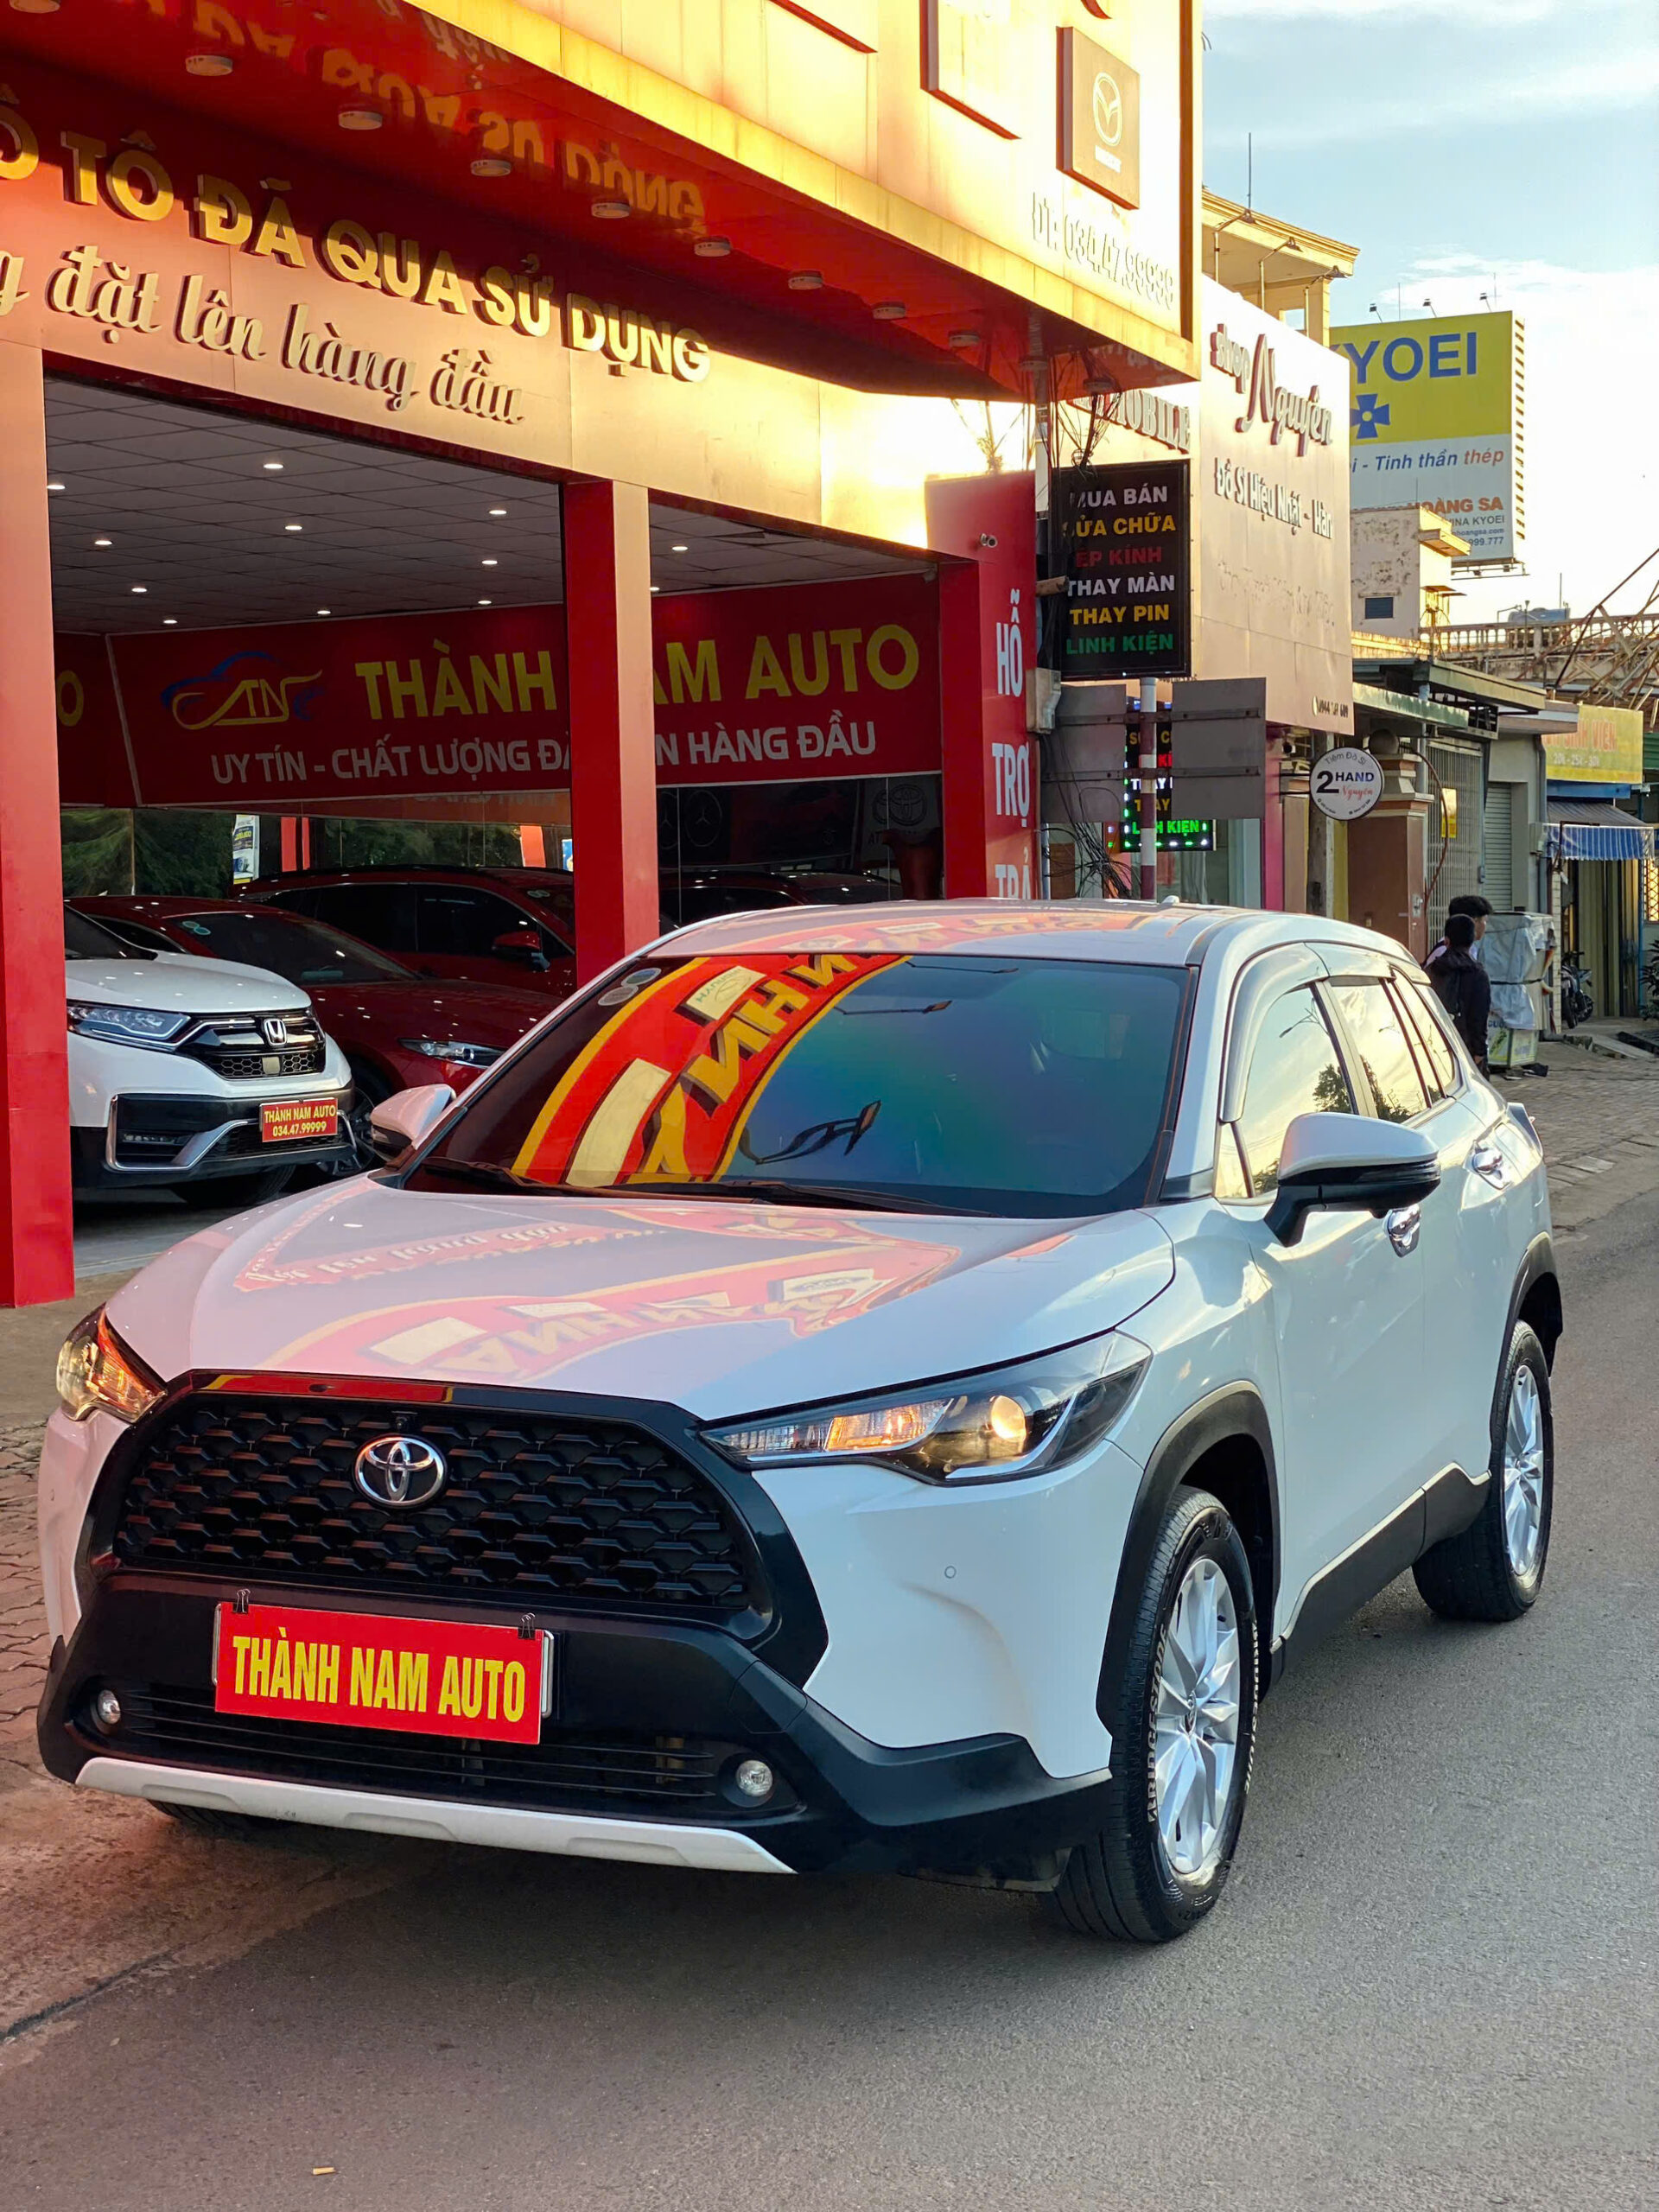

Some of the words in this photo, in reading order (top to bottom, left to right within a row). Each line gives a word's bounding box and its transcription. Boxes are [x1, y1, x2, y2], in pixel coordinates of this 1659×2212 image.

[60, 130, 175, 222] TÔ
[189, 173, 307, 269] ĐÃ
[317, 219, 468, 315] QUA
[474, 252, 555, 338] SỬ
[563, 292, 711, 383] DỤNG
[46, 245, 162, 344] đặt
[173, 274, 266, 361] lên
[282, 302, 420, 412] hàng
[429, 348, 525, 425] đầu
[1332, 331, 1477, 385] YOEI
[1235, 333, 1333, 457] Nguyên
[1376, 454, 1412, 471] Tinh
[1419, 448, 1458, 469] thần
[1464, 446, 1504, 466] thép
[1123, 482, 1168, 506] BÁN
[1478, 496, 1503, 512] SA
[1113, 511, 1177, 536] CHỮA
[1312, 499, 1333, 539] Hàn
[1472, 515, 1505, 525] KYOEI
[1109, 543, 1162, 566] KÍNH
[1068, 577, 1122, 597] THAY
[1127, 571, 1175, 594] MÀN
[1069, 606, 1127, 626] THAY
[1133, 603, 1170, 622] PIN
[995, 588, 1024, 698] HỖ
[1065, 636, 1116, 655] LINH
[1122, 629, 1174, 656] KIỆN
[354, 639, 558, 721] THÀNH
[745, 623, 920, 700] AUTO
[211, 753, 251, 785] UY
[254, 744, 308, 785] TÍN
[331, 733, 412, 779] CHẤT
[418, 736, 532, 783] LƯỢNG
[688, 721, 790, 766] HÀNG
[796, 709, 877, 760] ĐẦU
[991, 741, 1031, 828] TRỢ
[1316, 770, 1339, 794] 2
[1335, 772, 1375, 782] HAND
[264, 1106, 292, 1124] THÀNH
[293, 1106, 312, 1122] NAM
[313, 1104, 337, 1119] AUTO
[272, 1121, 327, 1137] 034.47.99999
[232, 1626, 340, 1704] THÀNH
[349, 1646, 429, 1713] NAM
[437, 1655, 526, 1723] AUTO
